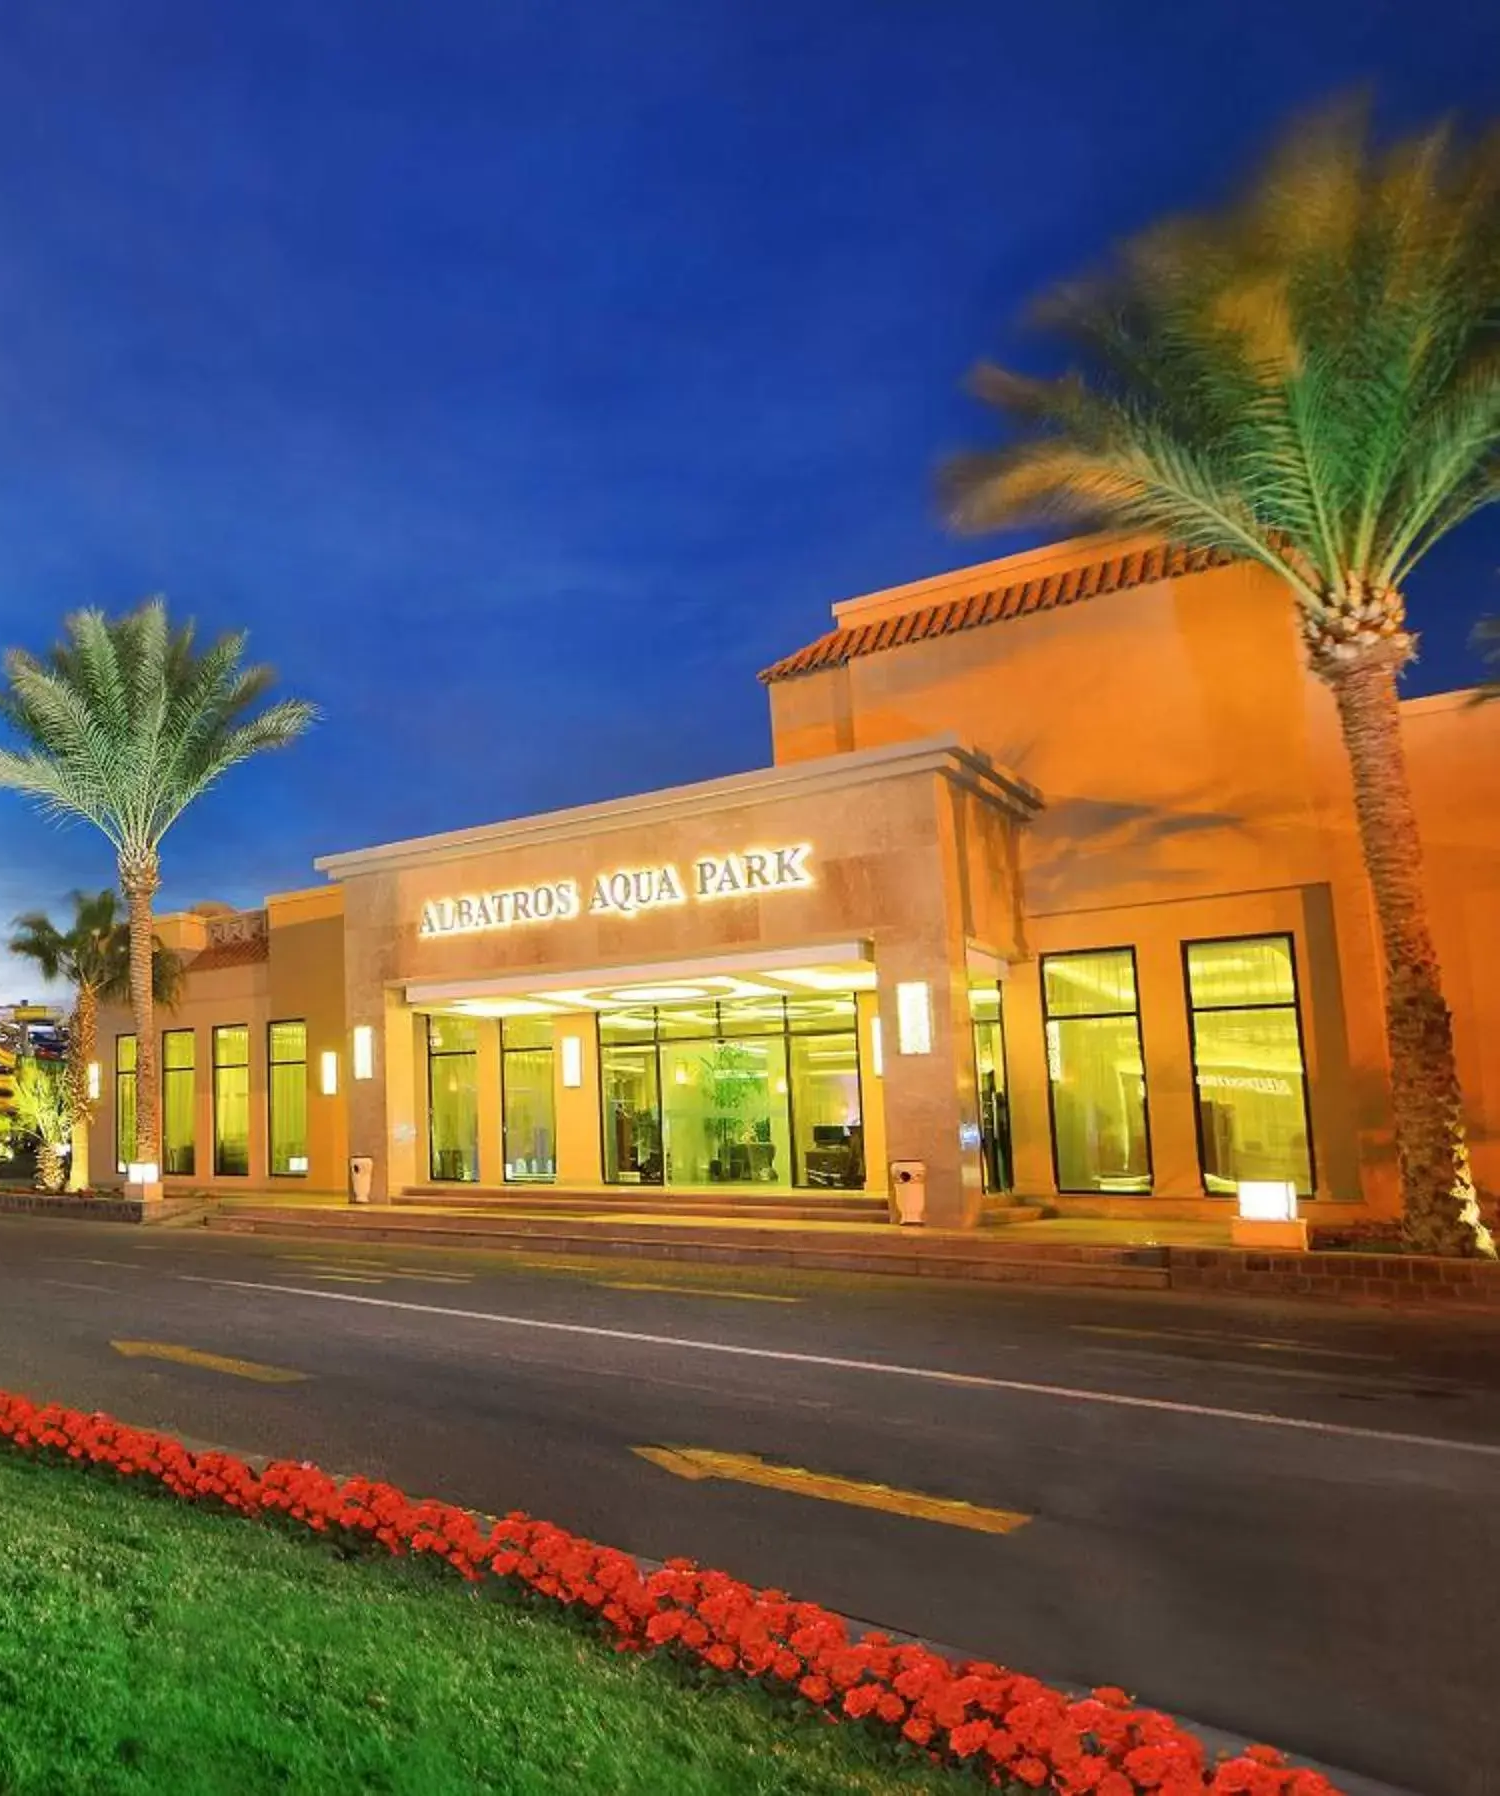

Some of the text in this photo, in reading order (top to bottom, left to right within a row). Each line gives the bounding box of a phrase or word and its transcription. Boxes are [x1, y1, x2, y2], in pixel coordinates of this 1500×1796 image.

[418, 846, 807, 935] ALBATROS AQUA PARK
